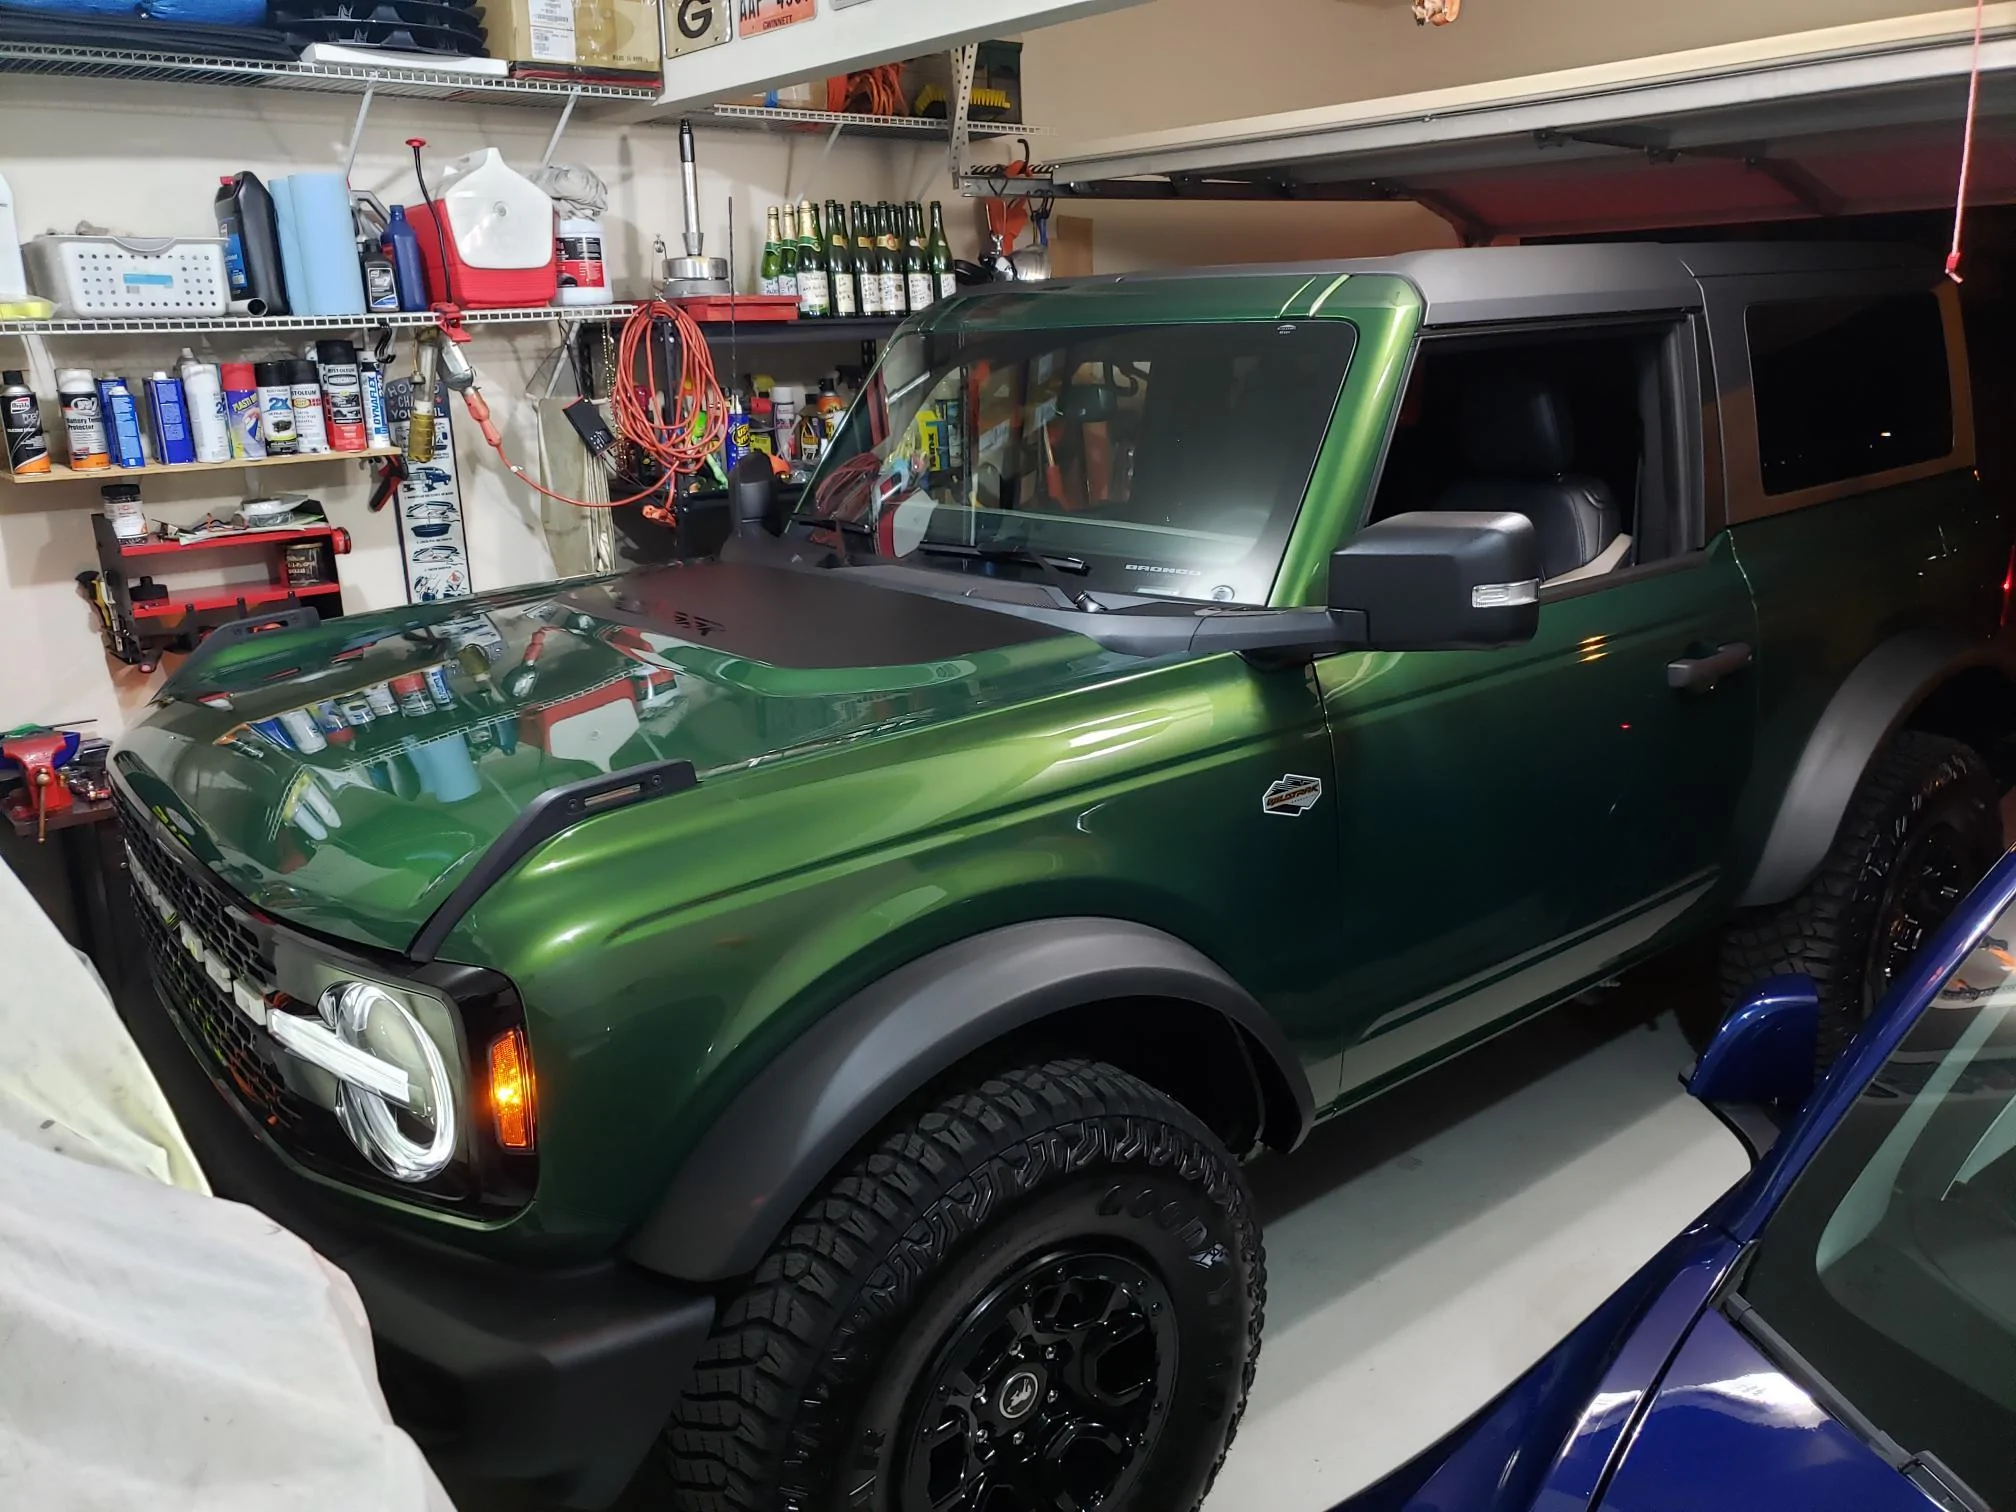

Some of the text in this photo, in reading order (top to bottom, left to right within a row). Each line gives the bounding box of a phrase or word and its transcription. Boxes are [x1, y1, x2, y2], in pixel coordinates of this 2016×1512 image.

[678, 0, 713, 39] G
[269, 397, 293, 411] 2X
[368, 376, 380, 425] DYNAFLEX
